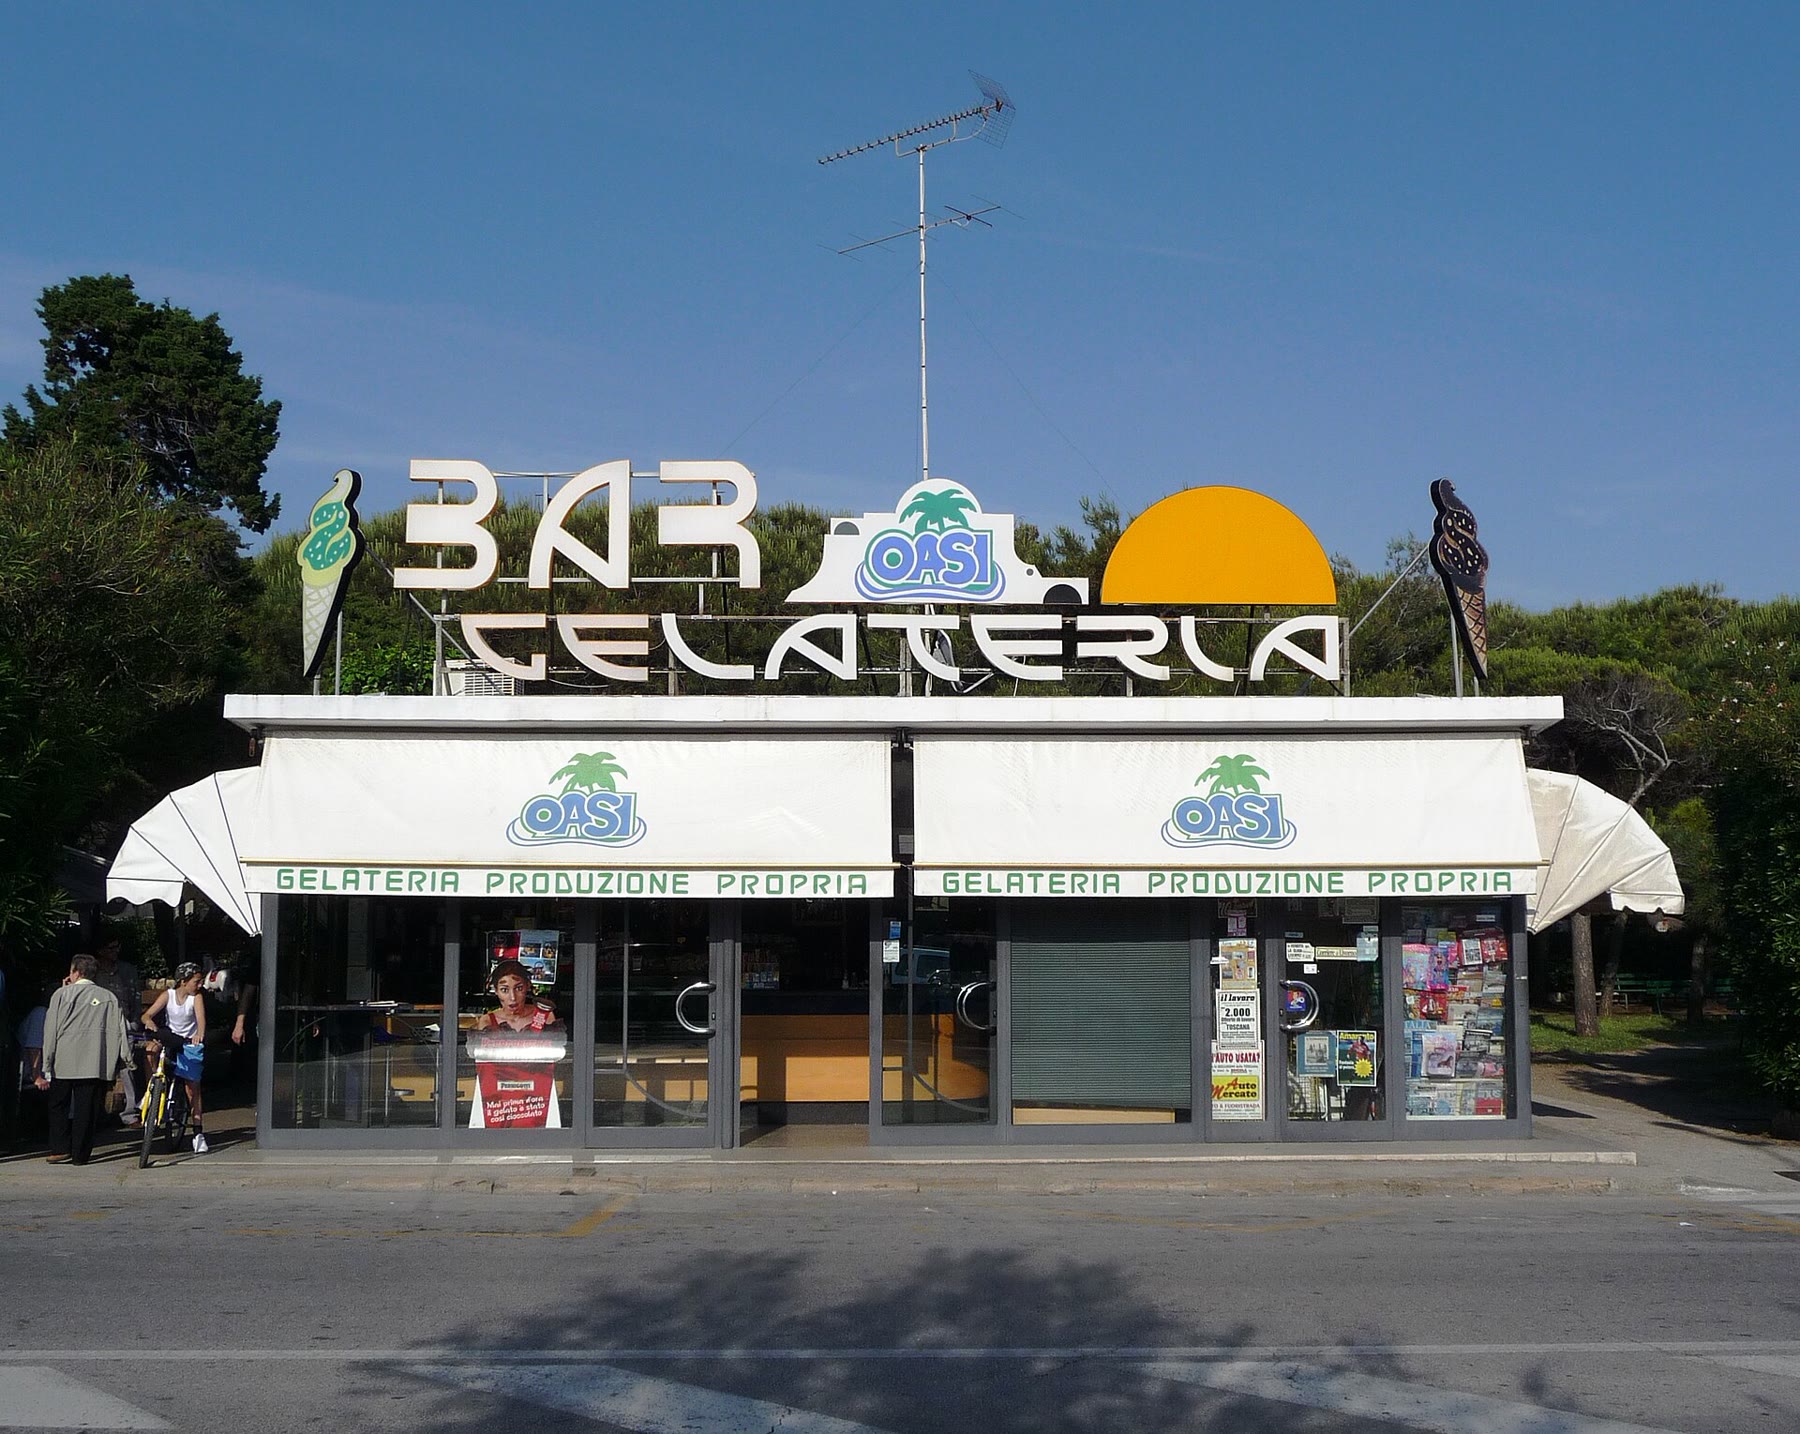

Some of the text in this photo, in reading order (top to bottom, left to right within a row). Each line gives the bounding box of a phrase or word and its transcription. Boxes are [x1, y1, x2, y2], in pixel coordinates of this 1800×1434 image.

[393, 459, 761, 590] BAR
[870, 532, 993, 586] OASI
[460, 613, 1340, 682] GELATERIA
[524, 793, 636, 838] OASI
[1175, 793, 1281, 839] OASI
[277, 868, 866, 894] GELATERIA PRODUZIONE PROPRIA
[943, 871, 1512, 893] GELATERIA PRODUZIONE PROPRIA
[1225, 1008, 1251, 1017] 2.000
[1235, 1053, 1260, 1063] USATA?
[1225, 1077, 1256, 1090] Auto
